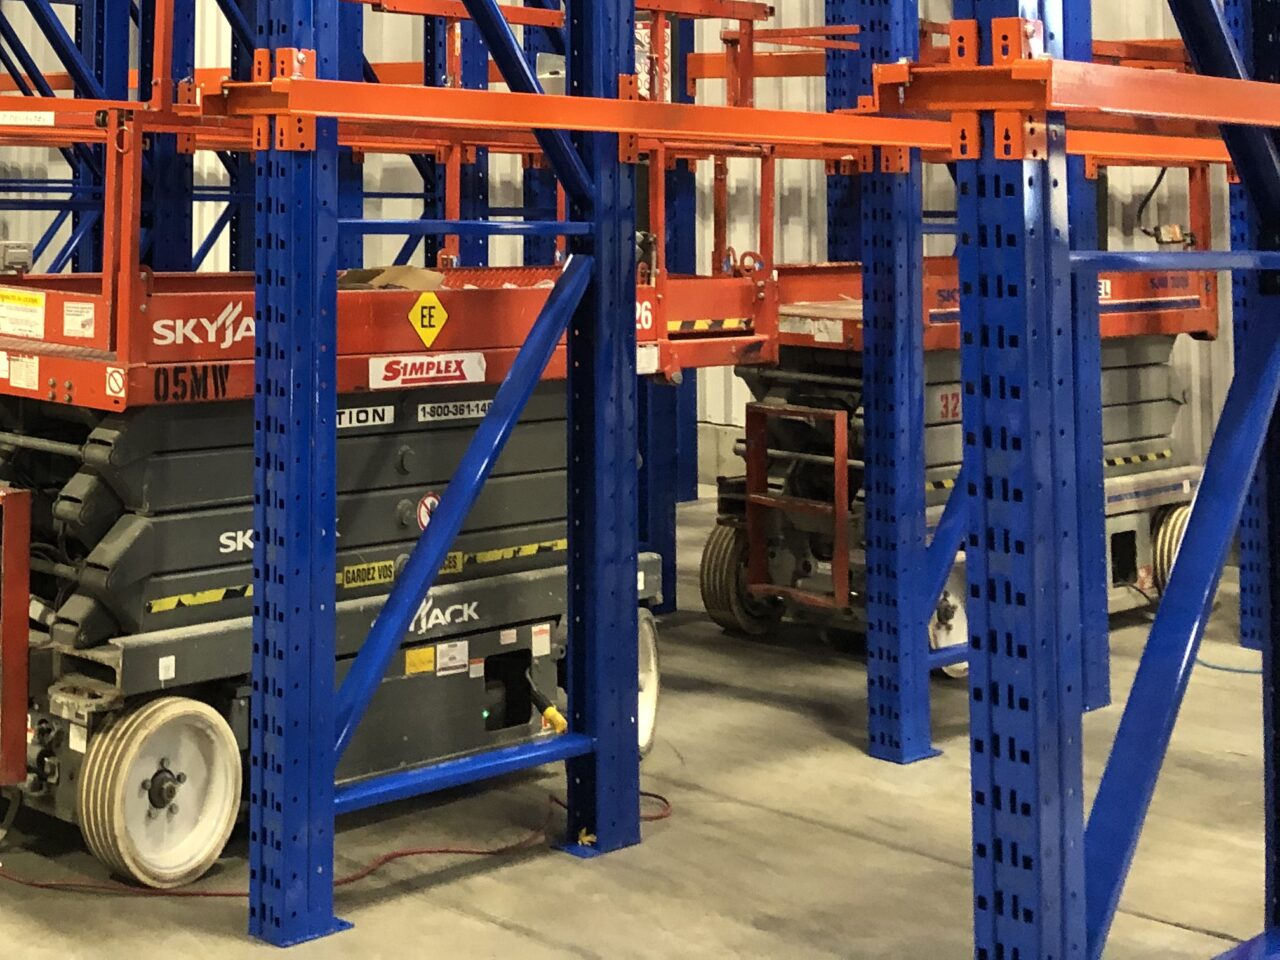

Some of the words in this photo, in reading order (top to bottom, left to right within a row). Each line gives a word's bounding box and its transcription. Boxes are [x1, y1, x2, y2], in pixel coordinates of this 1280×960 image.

[421, 305, 436, 328] EE
[154, 365, 230, 401] 05MW
[382, 360, 467, 383] SIMPLEX
[345, 566, 376, 585] GARDEZ
[377, 563, 393, 580] VOS
